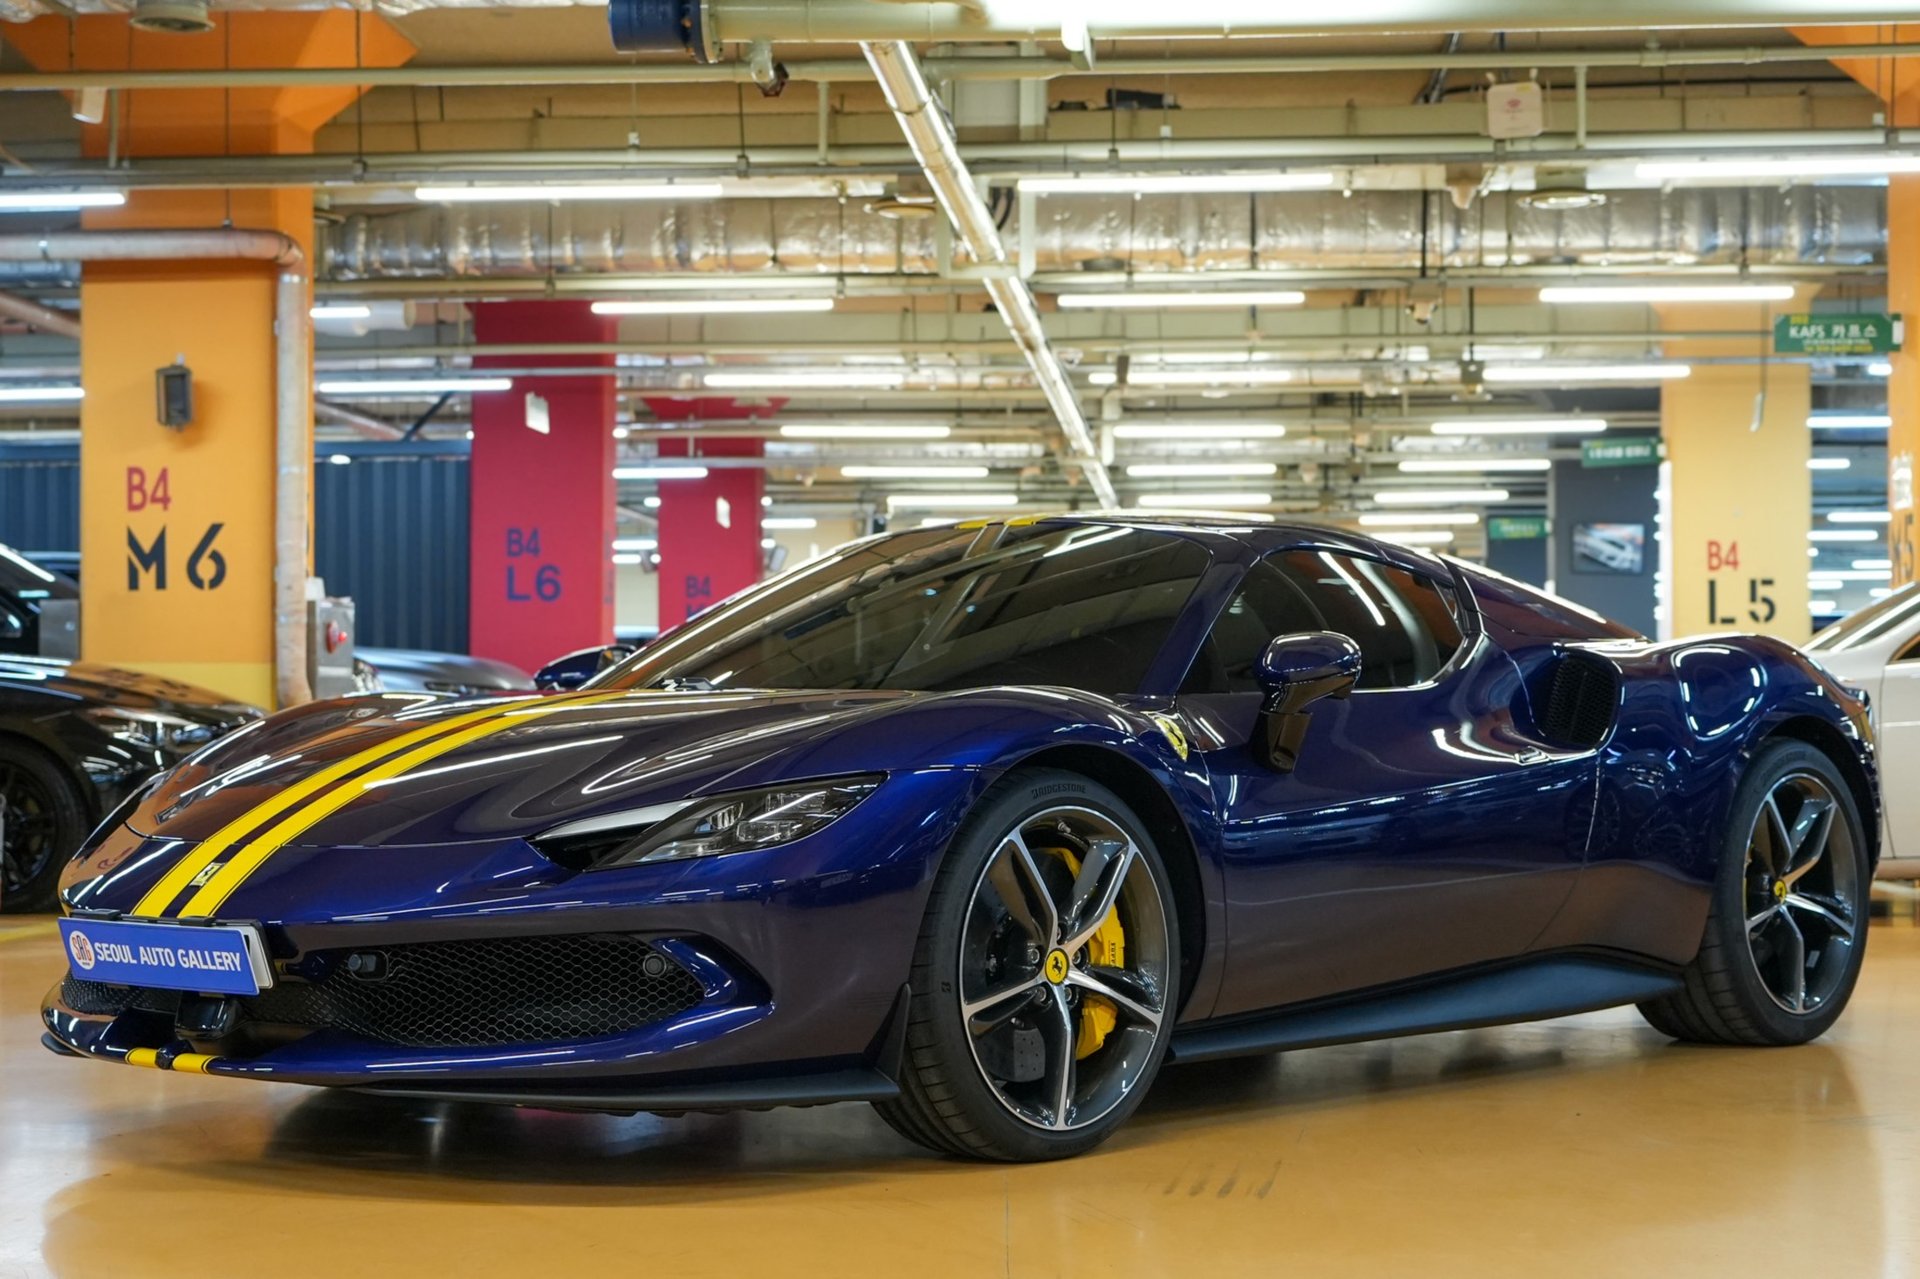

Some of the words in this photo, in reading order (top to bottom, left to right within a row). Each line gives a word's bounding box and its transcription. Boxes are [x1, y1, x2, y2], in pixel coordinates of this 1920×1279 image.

[127, 465, 172, 512] B4
[507, 527, 541, 558] B4
[1707, 540, 1740, 572] B4
[507, 564, 562, 602] L6
[685, 574, 711, 598] B4
[94, 942, 138, 964] SEOUL
[139, 946, 176, 968] AUTO
[178, 949, 242, 972] GALLERY
